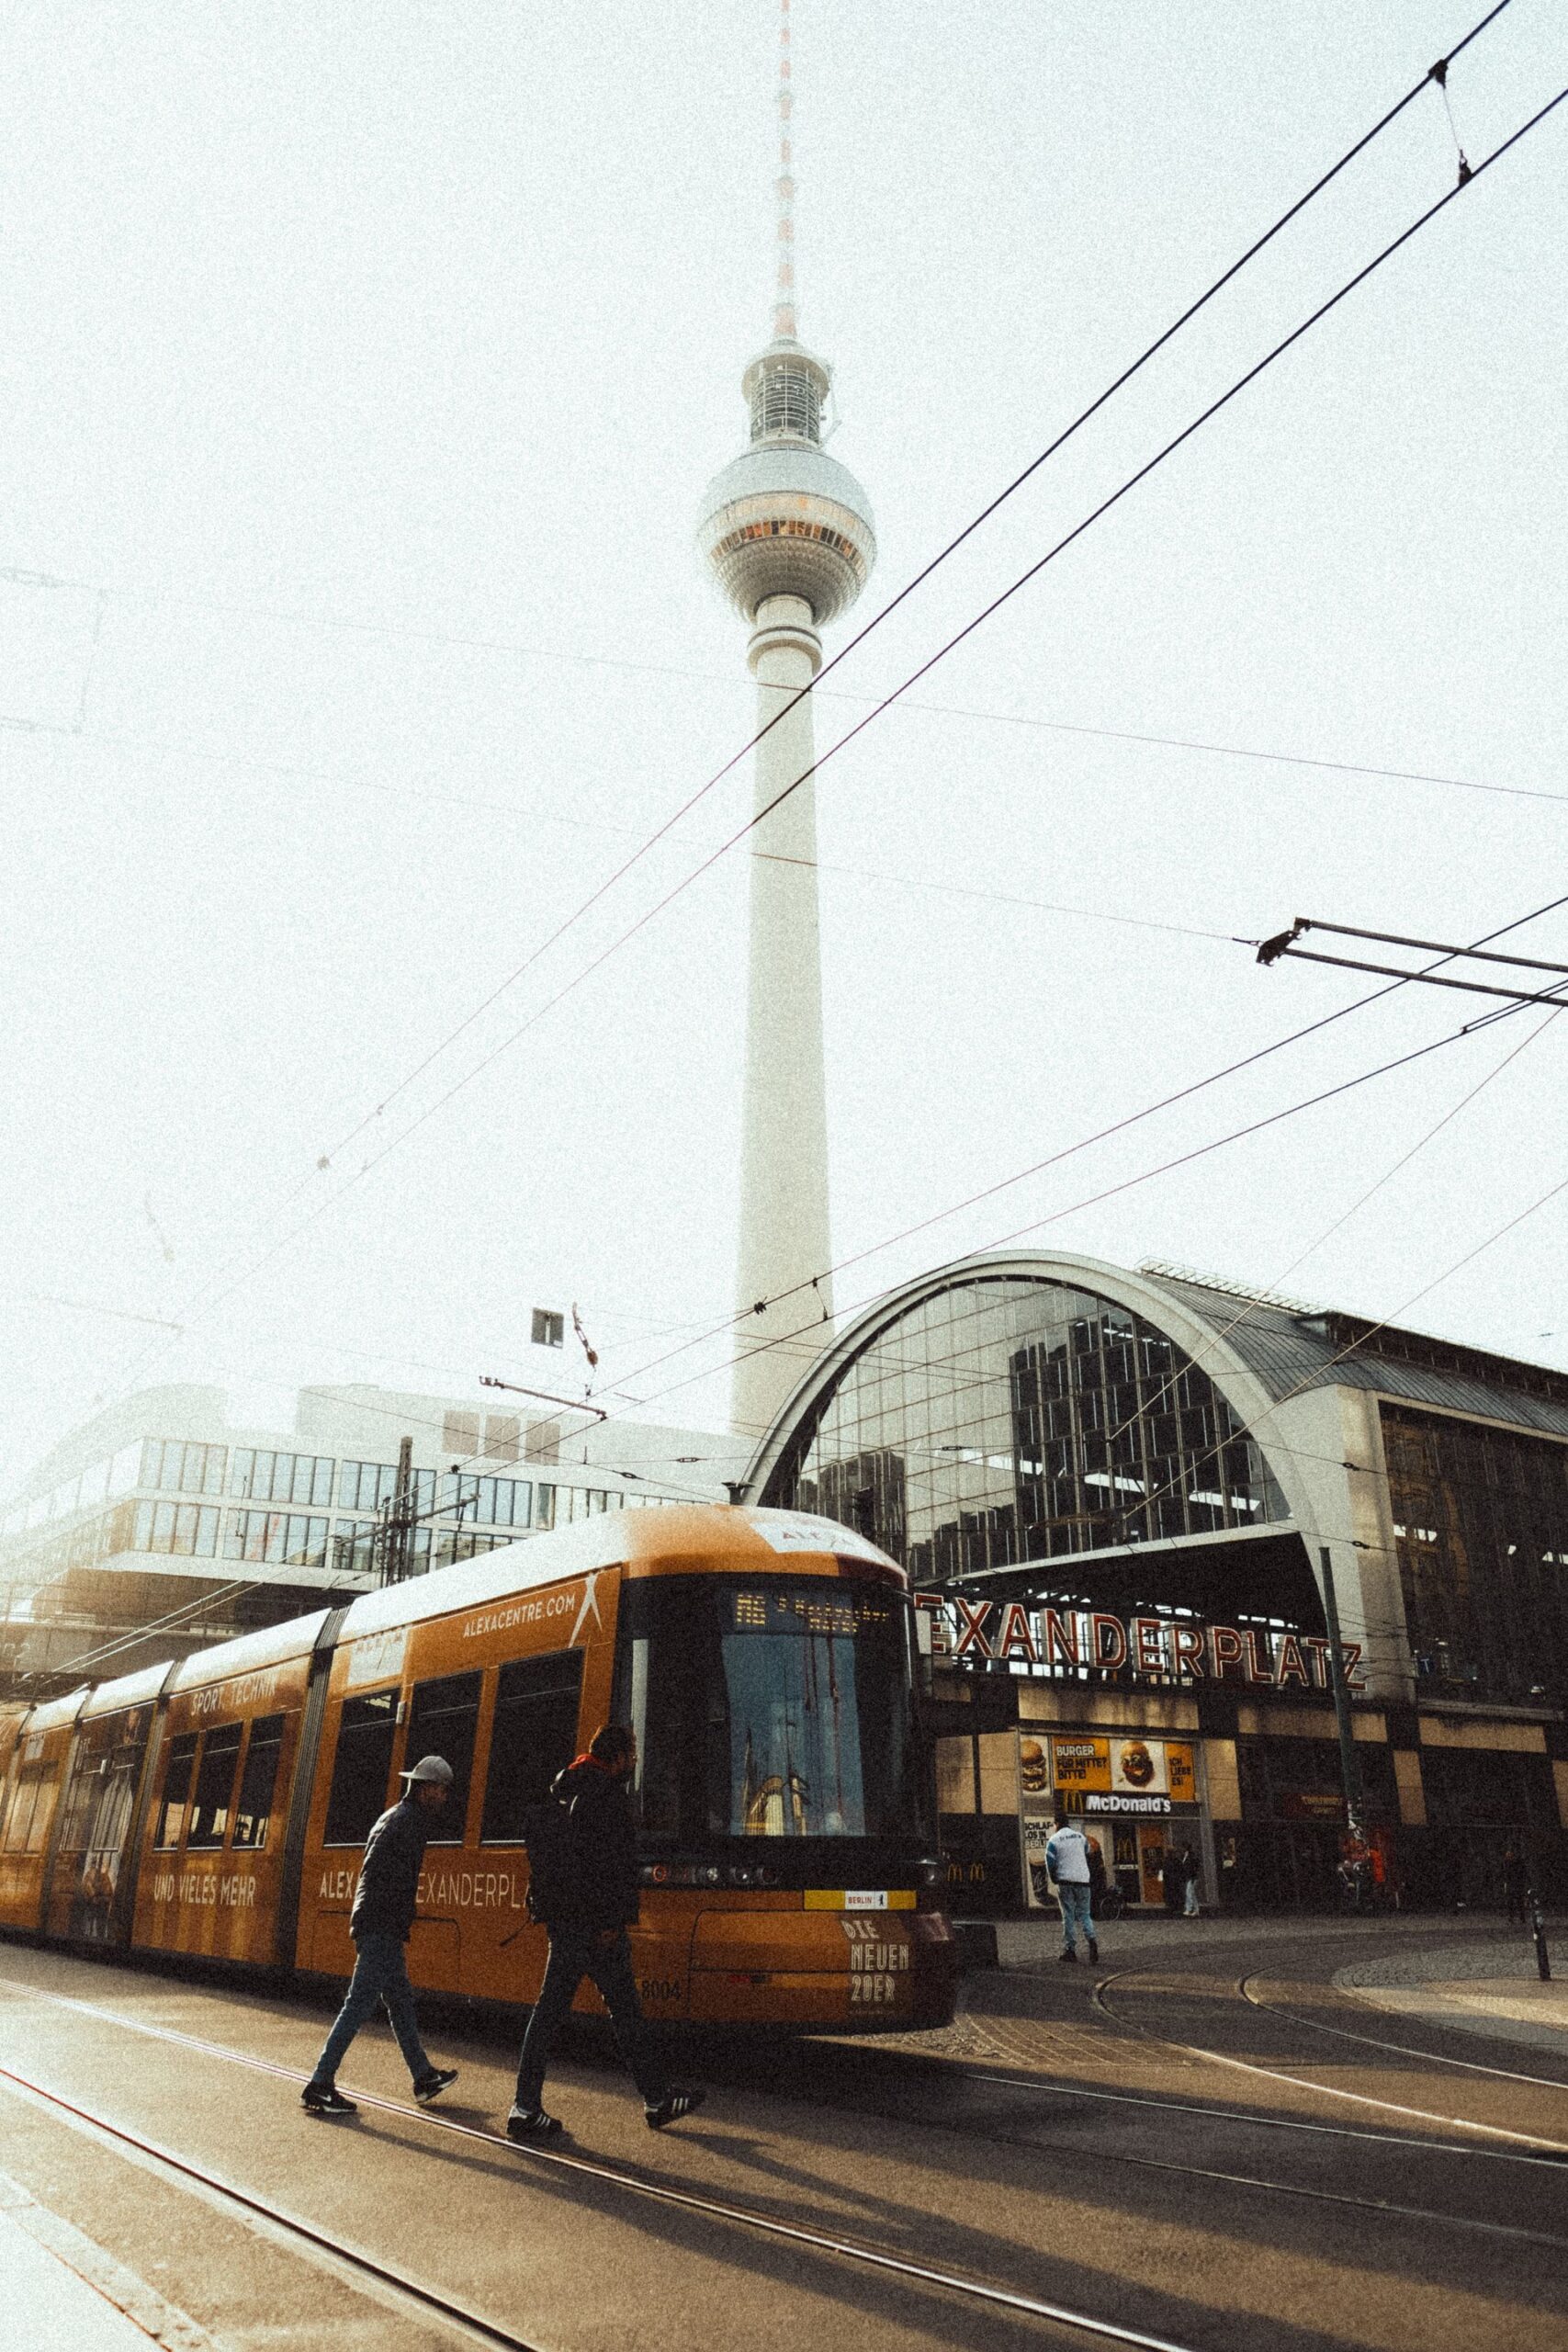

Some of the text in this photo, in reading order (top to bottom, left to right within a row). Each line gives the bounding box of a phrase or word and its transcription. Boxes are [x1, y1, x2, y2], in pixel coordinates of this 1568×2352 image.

[463, 1592, 576, 1638] ALEXACENTRE.COM
[1056, 1746, 1095, 1757] BURGER
[1086, 1794, 1171, 1813] McDonald's
[153, 1874, 256, 1906] UND VIELES MEHR
[319, 1871, 355, 1899] ALEX
[840, 1920, 879, 1939] DIE
[851, 1943, 909, 1971] NEUEN
[851, 1975, 896, 2002] 20ER
